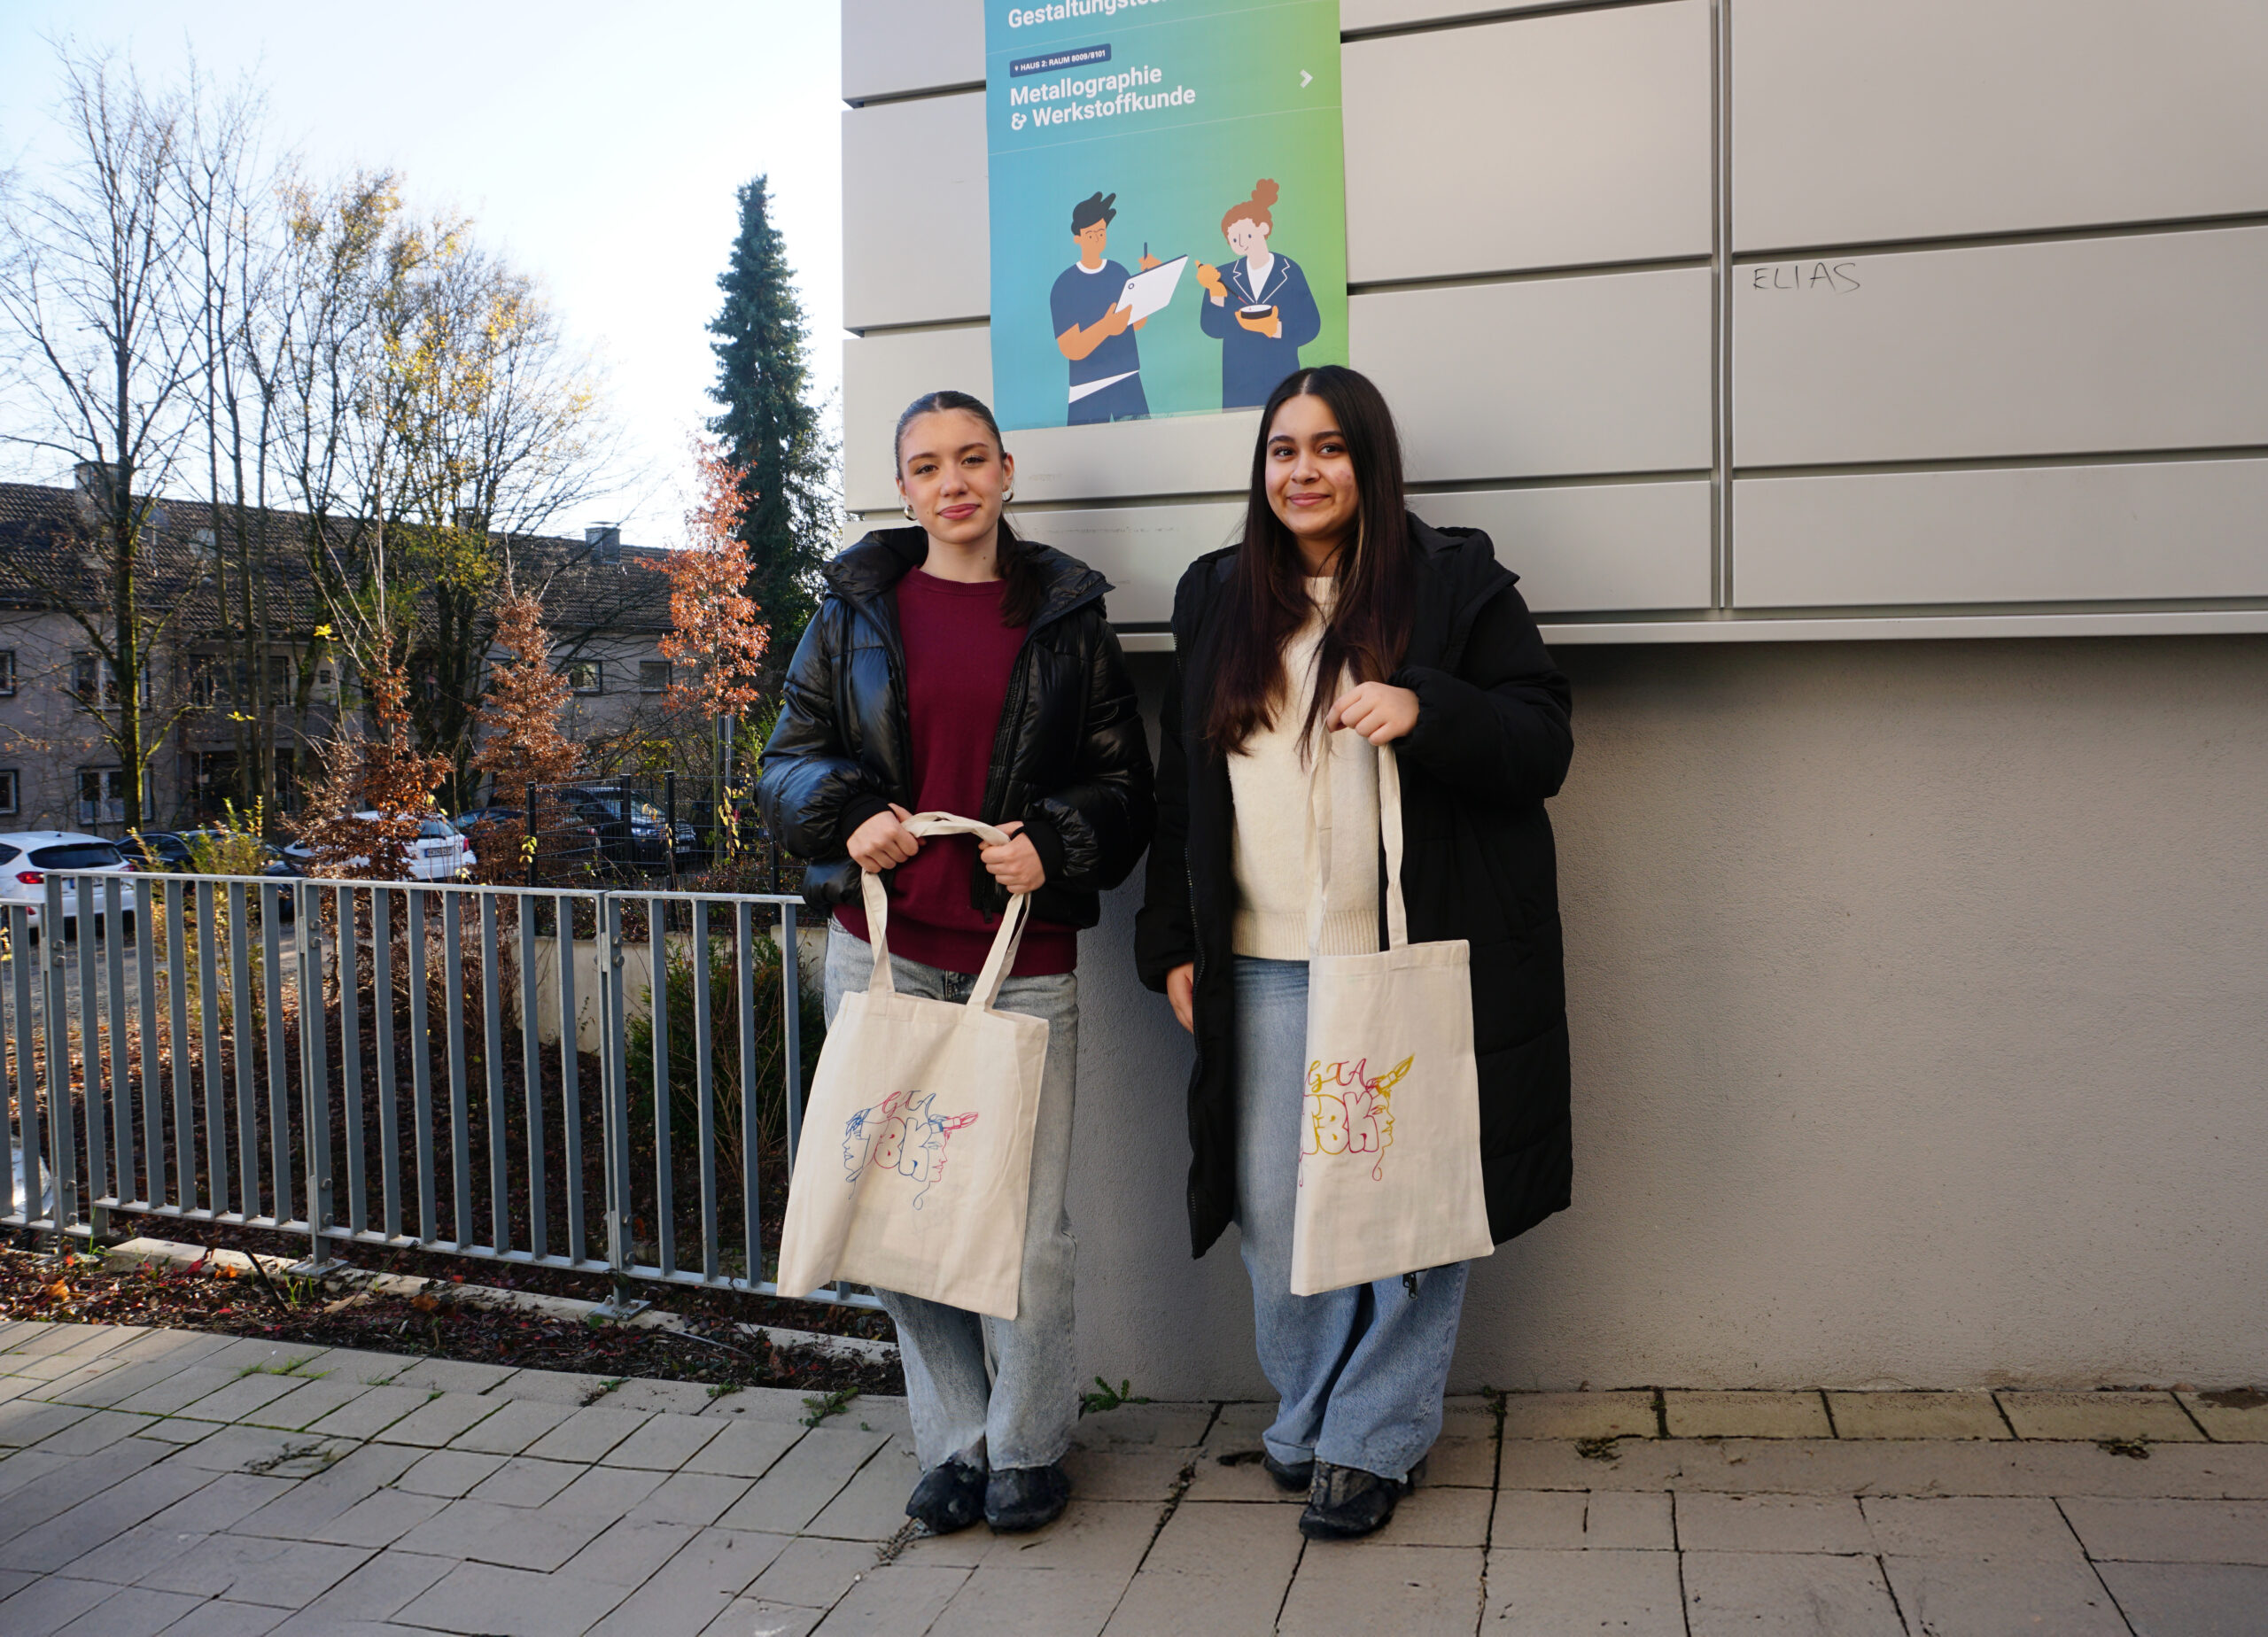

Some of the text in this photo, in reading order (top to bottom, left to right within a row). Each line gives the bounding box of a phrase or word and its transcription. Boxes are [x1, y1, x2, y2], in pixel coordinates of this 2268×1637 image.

[1020, 61, 1040, 71] HAUS
[1049, 56, 1070, 66] RAUM
[1010, 65, 1162, 106] Metallographie
[1011, 85, 1196, 130] & Werkstoffkunde
[1753, 262, 1860, 295] ELIAS
